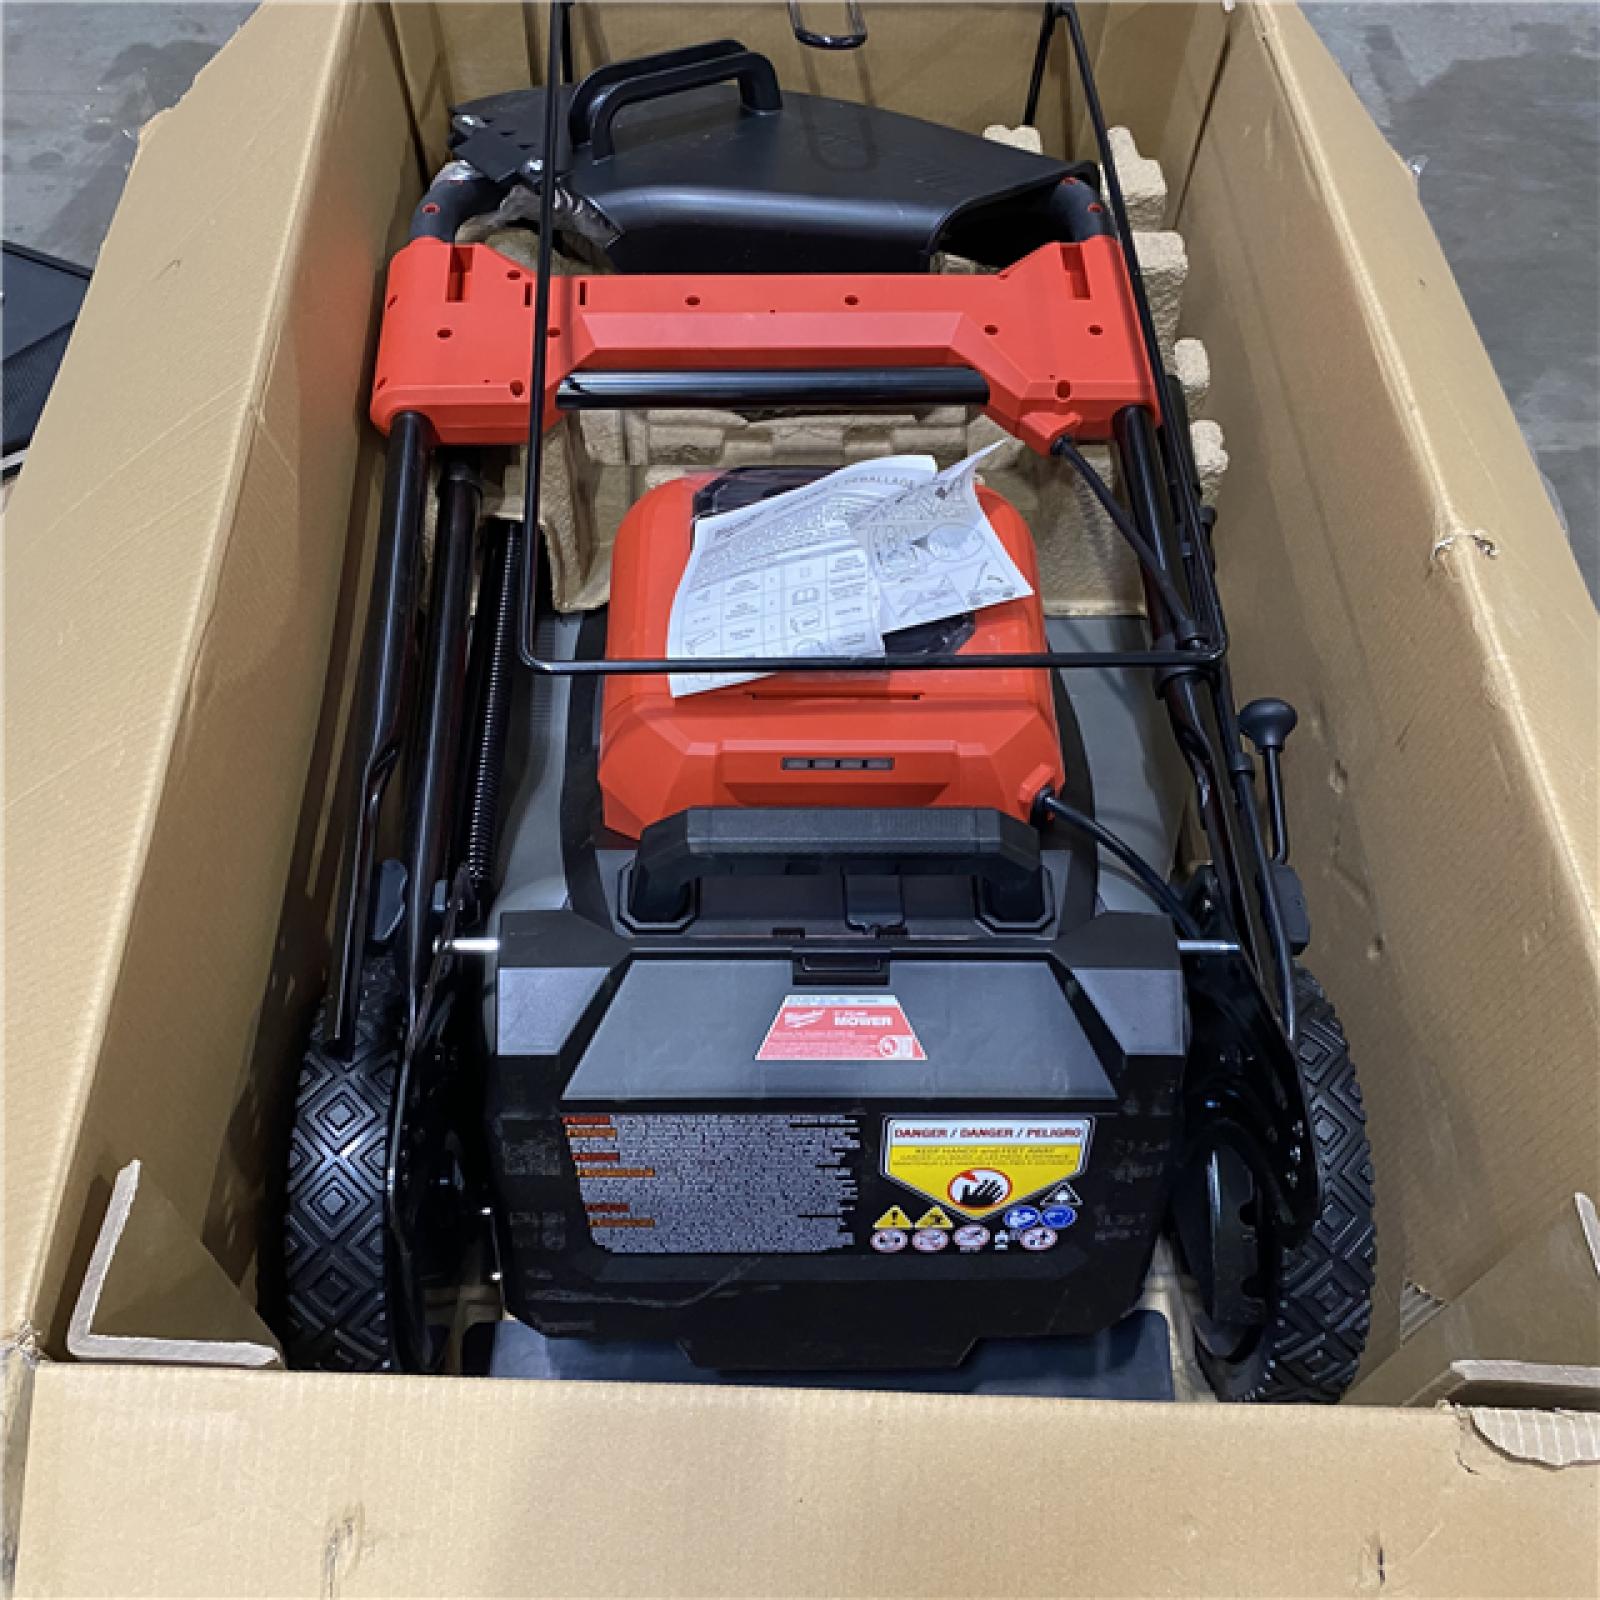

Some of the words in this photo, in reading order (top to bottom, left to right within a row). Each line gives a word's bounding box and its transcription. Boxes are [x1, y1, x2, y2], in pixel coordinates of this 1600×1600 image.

[834, 1016, 893, 1026] MOWER
[894, 1128, 948, 1138] DANGER
[959, 1128, 1013, 1138] DANGER
[1027, 1127, 1082, 1138] PELIGRO
